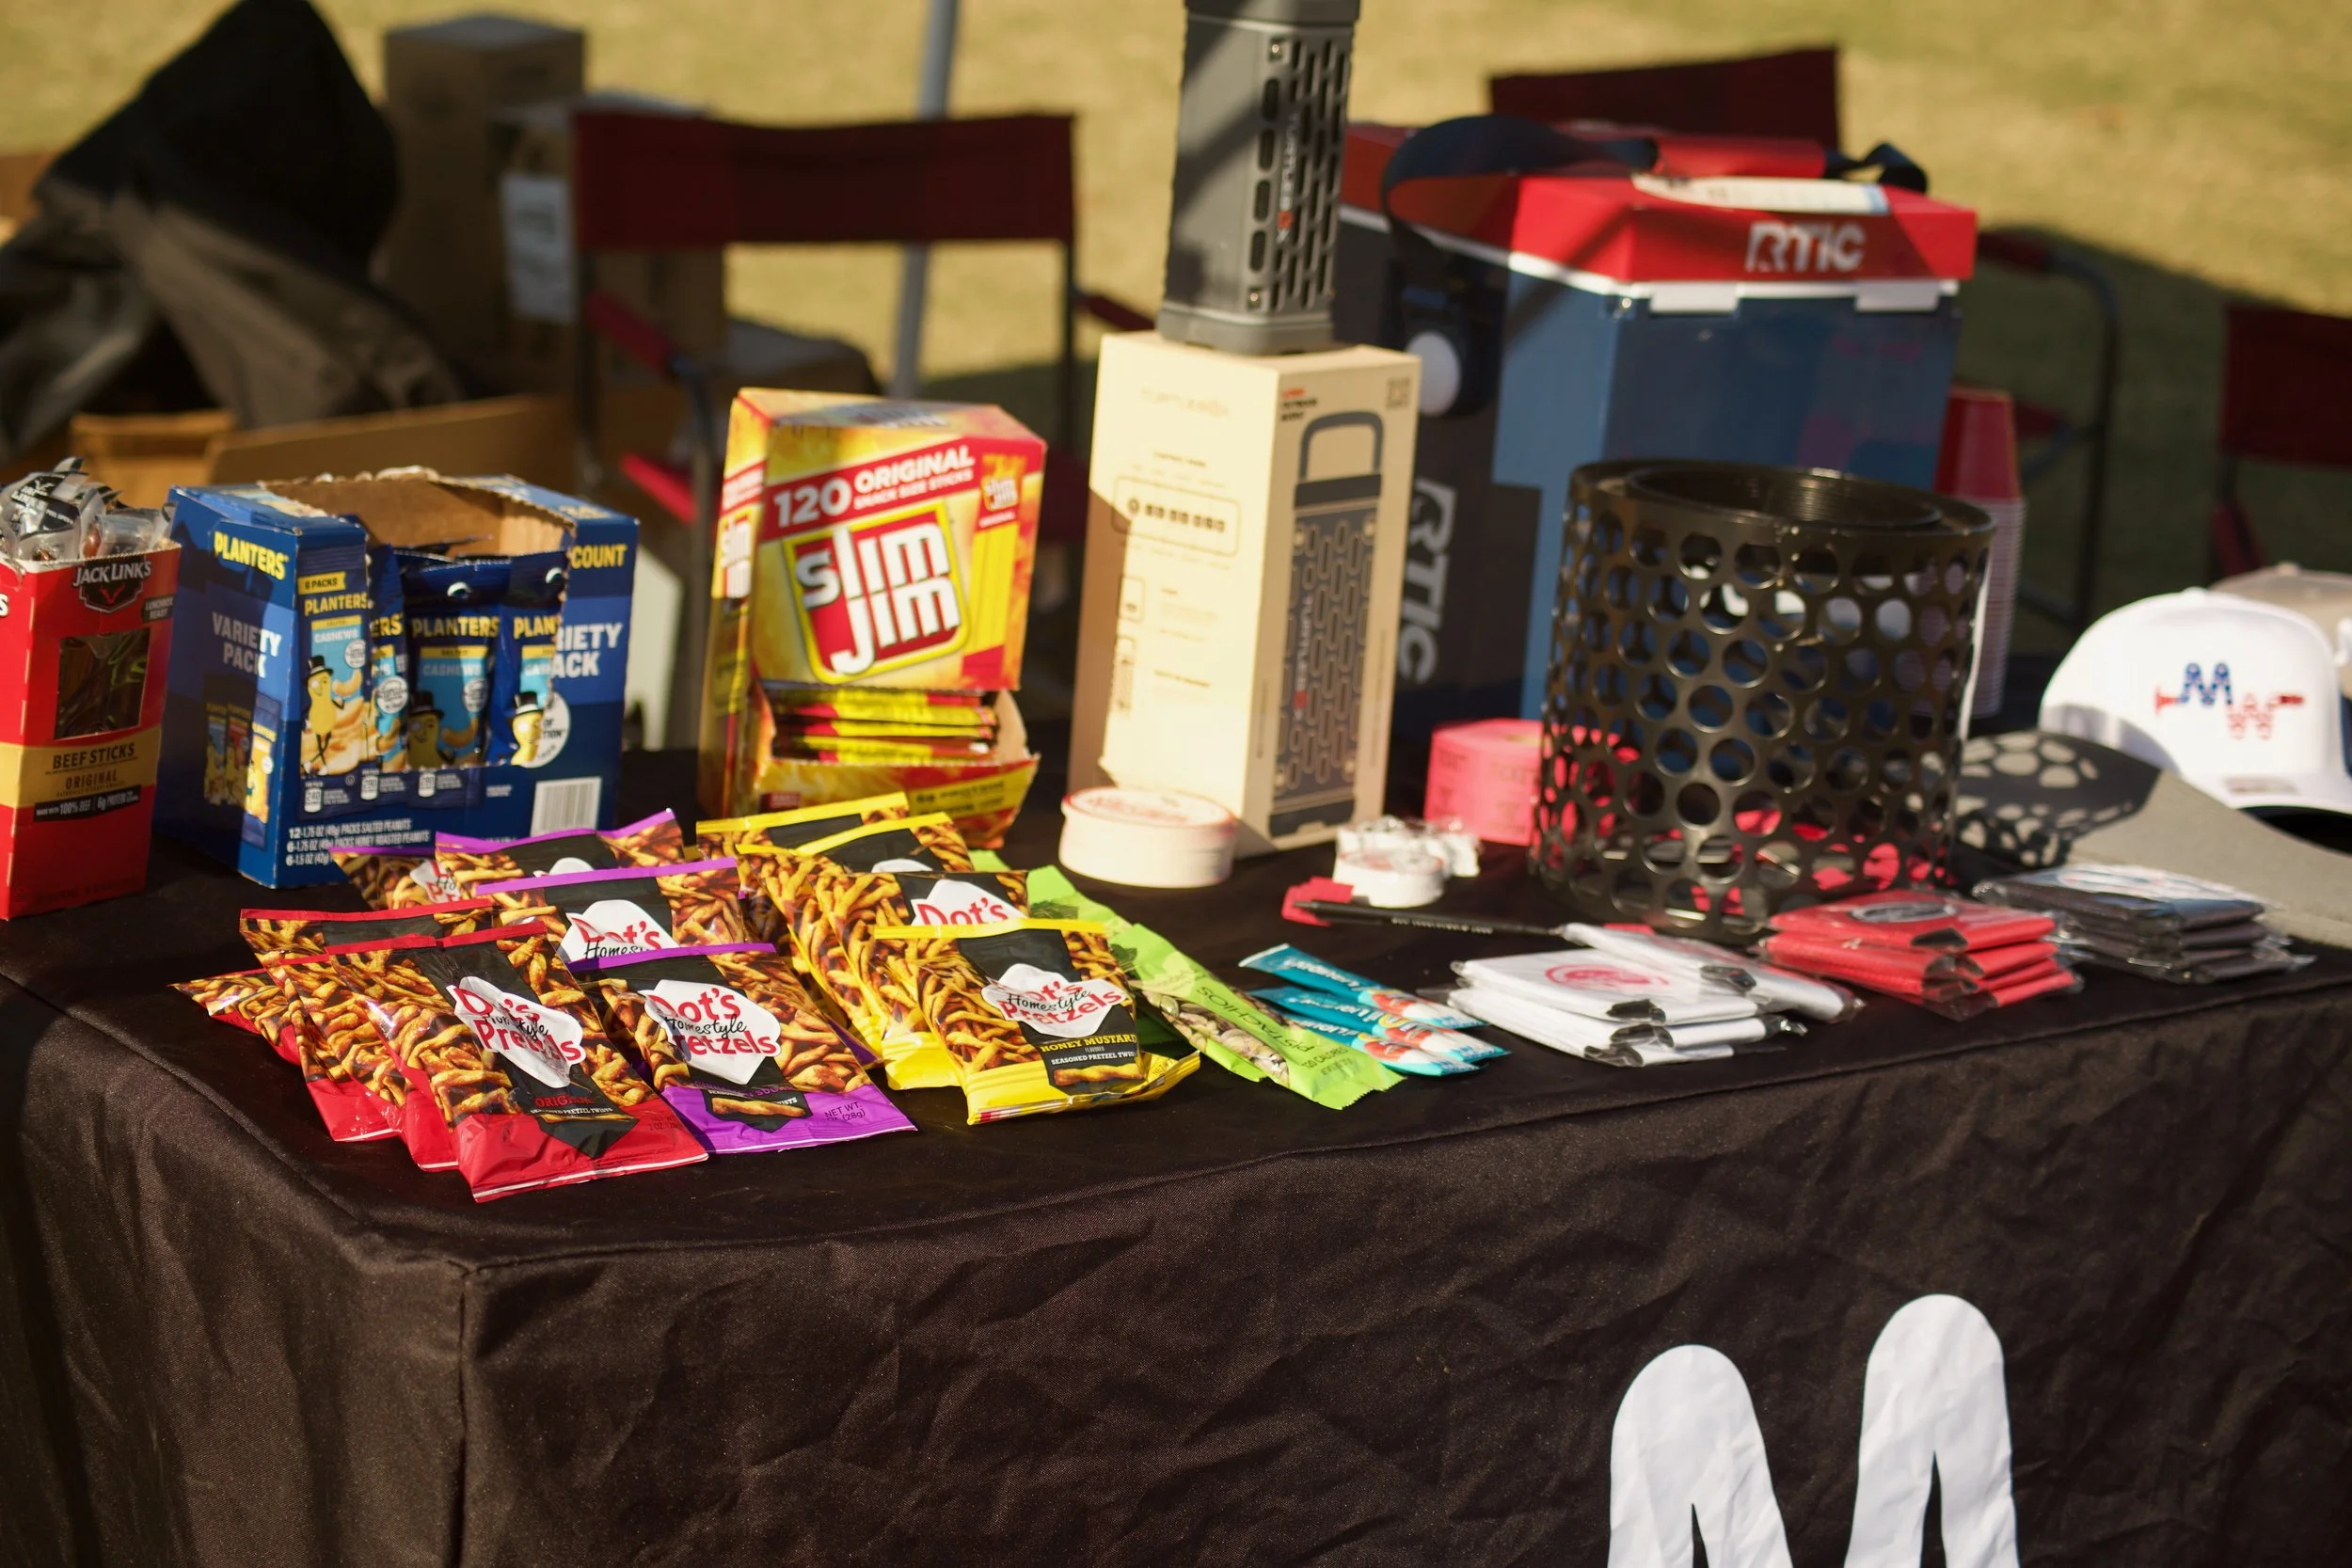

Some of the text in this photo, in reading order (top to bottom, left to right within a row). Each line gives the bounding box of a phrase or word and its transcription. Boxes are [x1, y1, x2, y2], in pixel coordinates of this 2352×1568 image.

[1744, 220, 1867, 273] RTIC
[854, 446, 976, 493] ORIGINAL
[930, 469, 974, 491] STICKS
[774, 478, 852, 527] 120
[214, 531, 287, 580] PLANTERS
[572, 544, 628, 569] COUNT
[72, 567, 110, 586] JACK
[311, 578, 338, 589] PACKS
[150, 609, 168, 620] READY
[304, 592, 368, 616] PLANTERS
[212, 611, 281, 657] VARIETY
[411, 616, 500, 638] PLANTERS
[513, 613, 561, 640] PLAN
[223, 642, 267, 678] PACK
[53, 742, 135, 769] BEEF STICKS
[65, 769, 118, 790] ORIGINAL
[917, 896, 1009, 926] Dot's
[997, 990, 1122, 1024] Pretzels
[1007, 990, 1092, 1013] Homestyle
[1197, 987, 1315, 1053] PISTACHIOS
[1040, 1039, 1083, 1053] HONEY
[1051, 1055, 1089, 1066] SEASONED
[1089, 1052, 1117, 1061] PRETZEL
[824, 1105, 843, 1118] NET
[842, 1108, 866, 1122] (28g)
